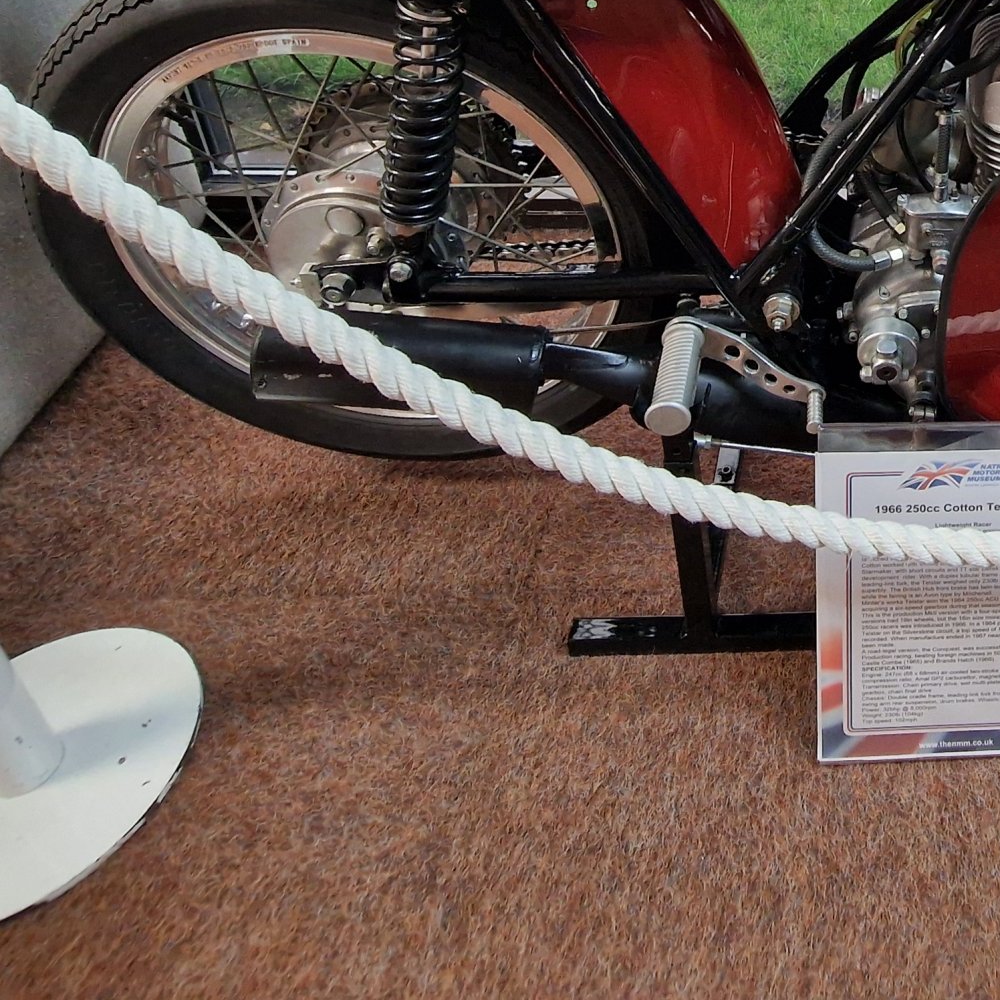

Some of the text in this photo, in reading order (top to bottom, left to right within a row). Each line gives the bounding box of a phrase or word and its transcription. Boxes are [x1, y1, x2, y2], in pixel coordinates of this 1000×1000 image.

[875, 504, 902, 514] 1966
[906, 503, 940, 513] 250cc
[943, 502, 983, 512] Cotton
[919, 738, 994, 748] www.thenmm.co.uk
